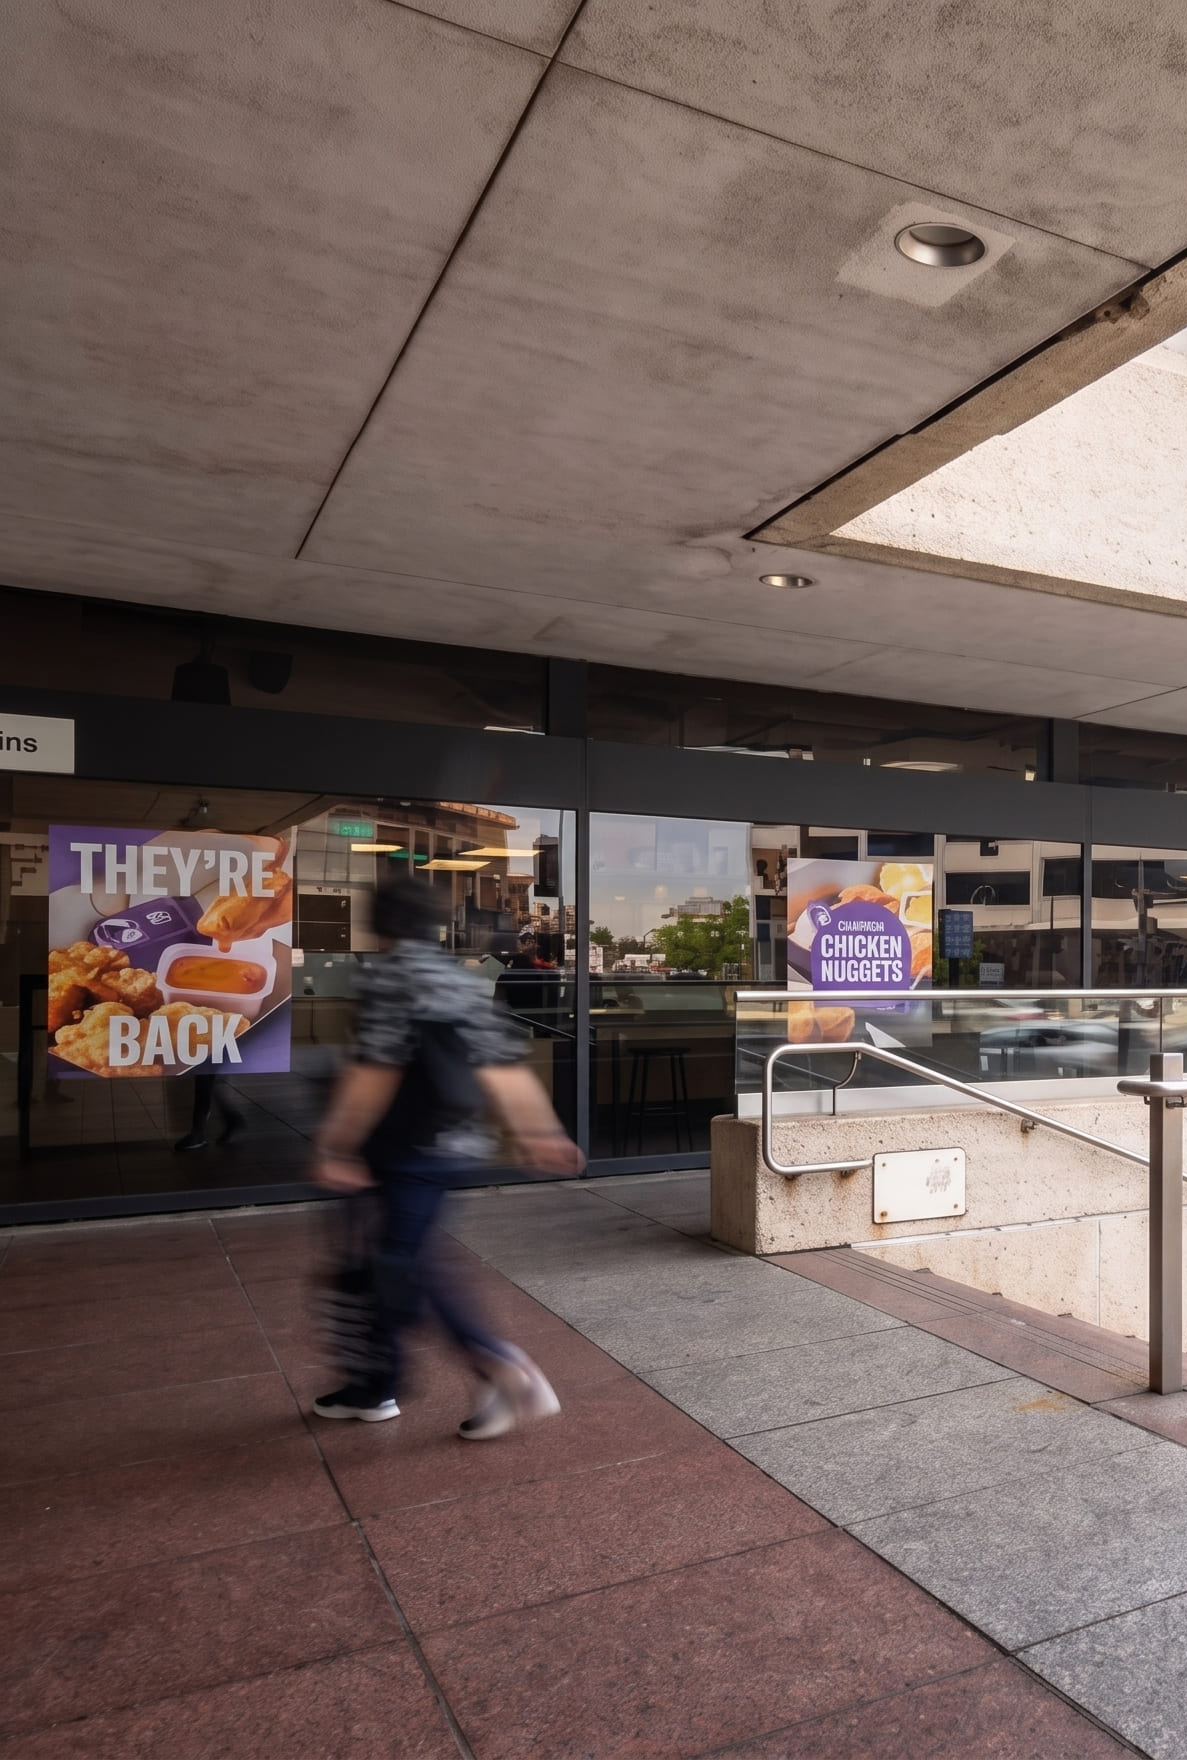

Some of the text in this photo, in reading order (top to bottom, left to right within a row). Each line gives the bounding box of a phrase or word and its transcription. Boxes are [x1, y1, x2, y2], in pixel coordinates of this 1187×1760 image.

[70, 842, 275, 898] THEY'RE
[821, 934, 902, 958] CHICKEN
[821, 959, 903, 982] NUGGETS
[109, 1013, 243, 1067] BACK
